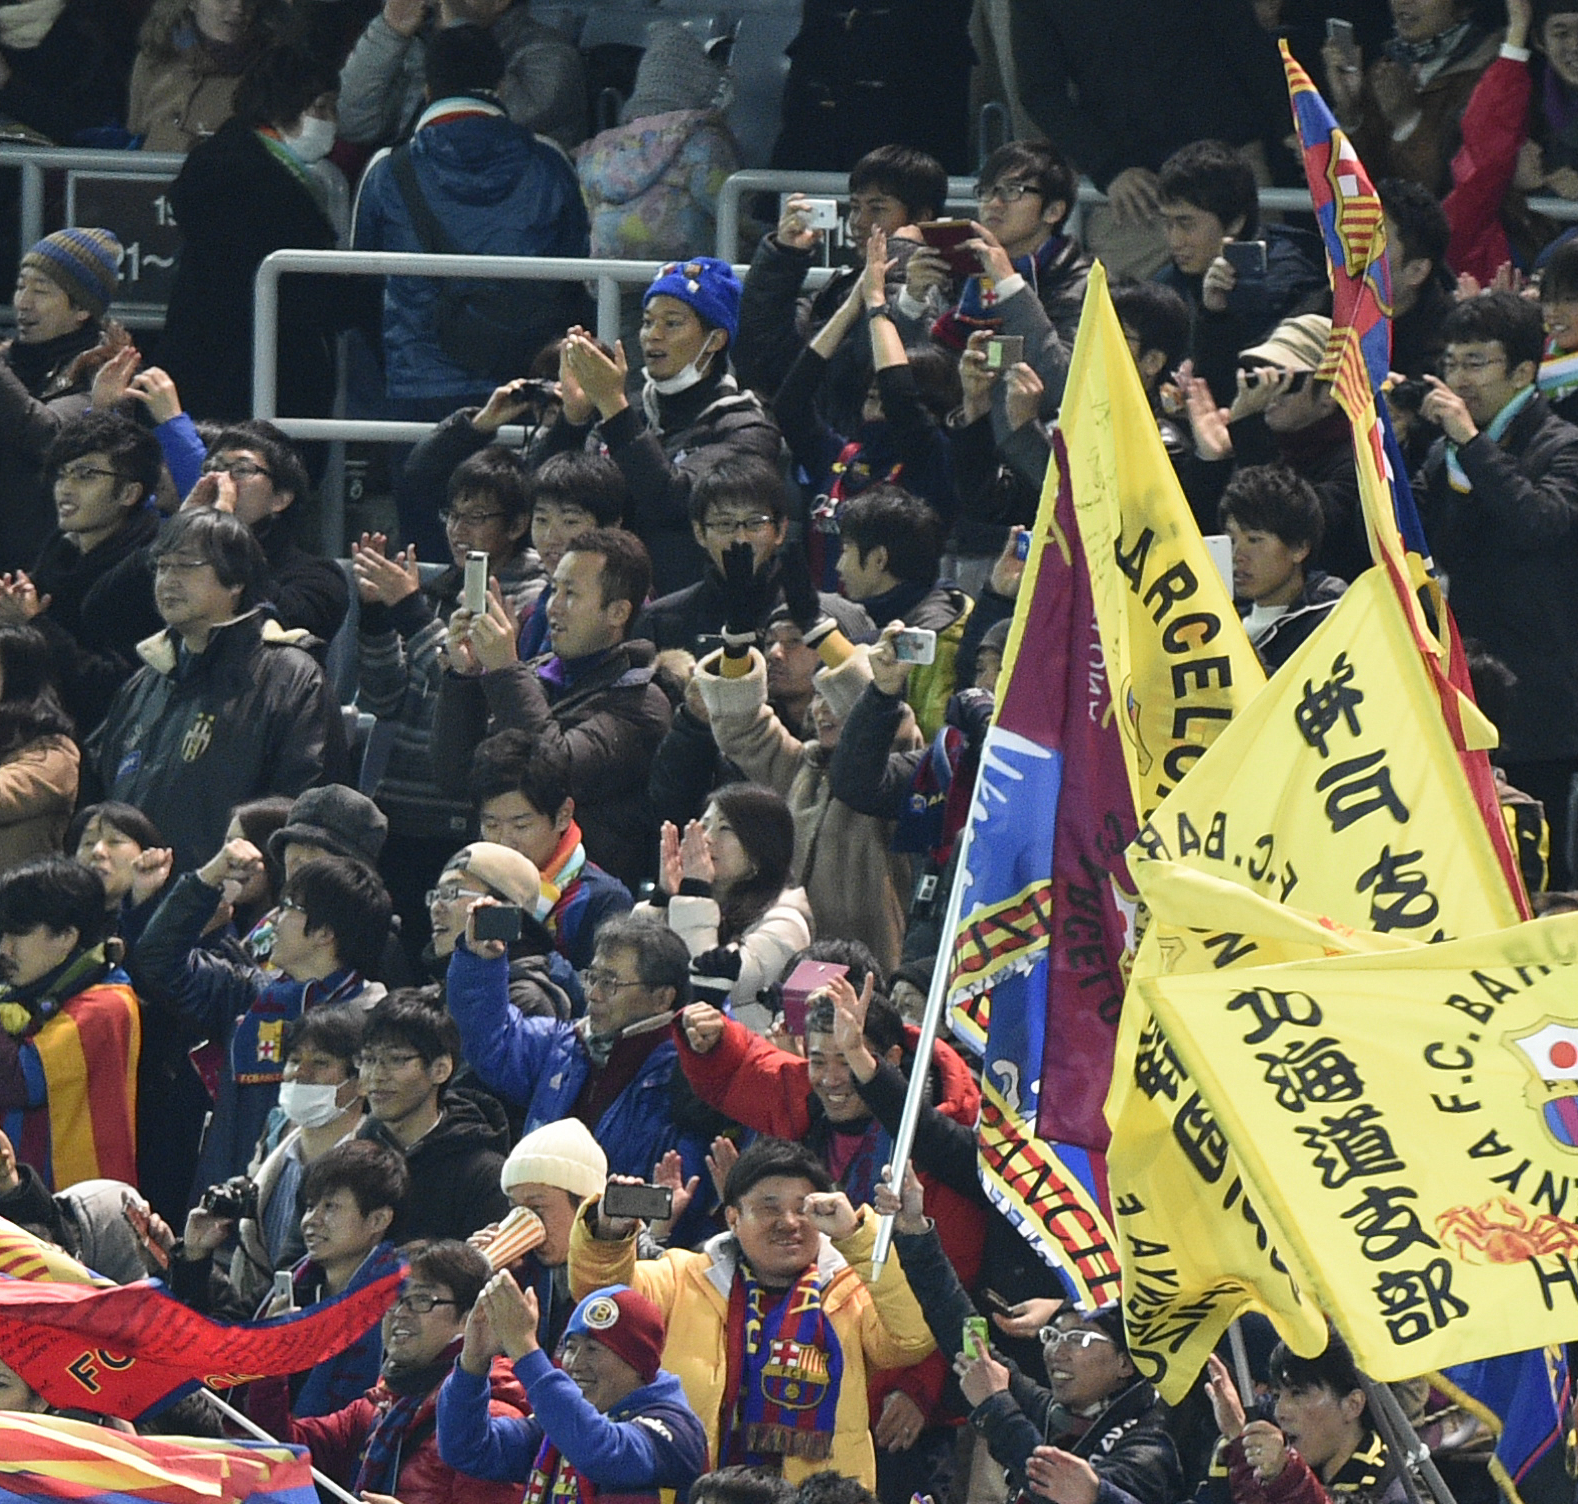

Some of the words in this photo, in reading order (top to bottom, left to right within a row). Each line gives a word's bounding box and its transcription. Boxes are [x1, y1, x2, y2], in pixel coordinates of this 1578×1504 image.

[1227, 986, 1469, 1344] 北海道支部
